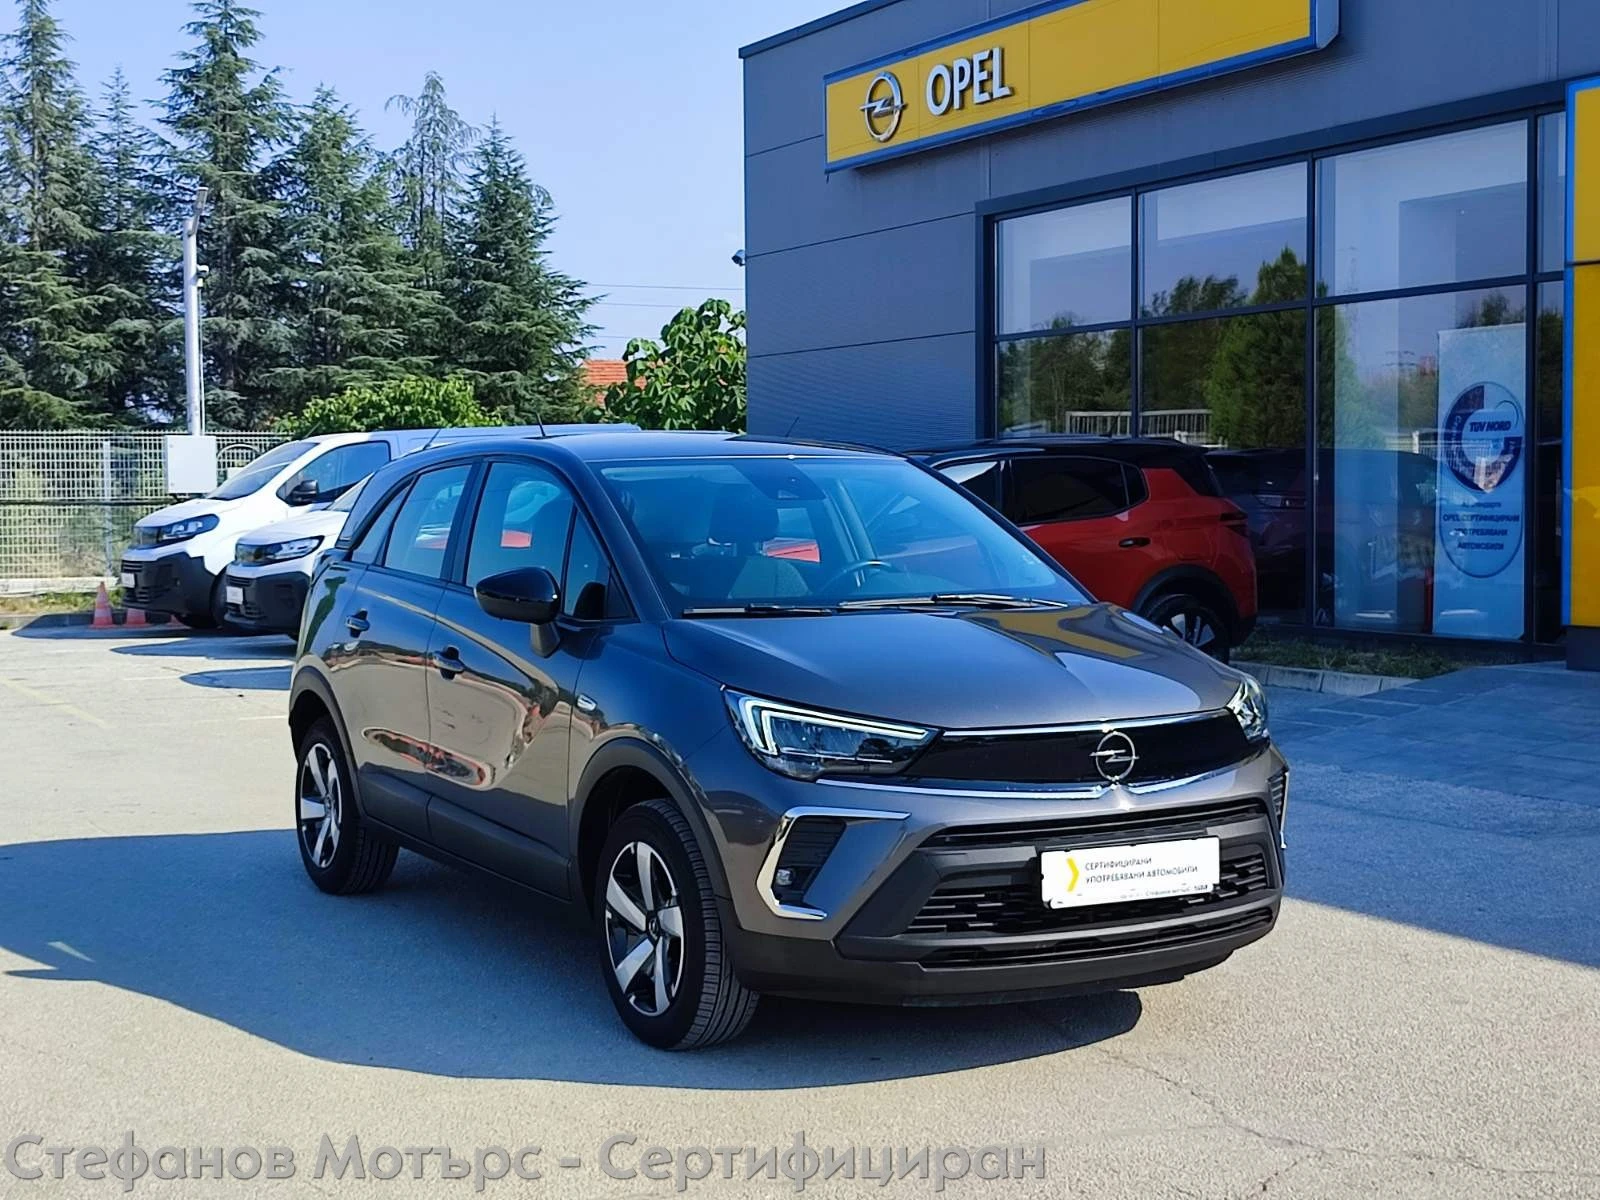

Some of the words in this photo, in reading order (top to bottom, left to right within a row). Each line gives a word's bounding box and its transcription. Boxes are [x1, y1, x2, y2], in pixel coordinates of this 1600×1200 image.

[926, 47, 1013, 116] OPEL
[1486, 420, 1511, 431] NORD
[1085, 857, 1152, 871] СЕРТИФИЦИРАНИ
[1086, 871, 1145, 884] УПОТРЕБЯВАНИ
[1146, 865, 1198, 878] АВТОМОБИЛИ
